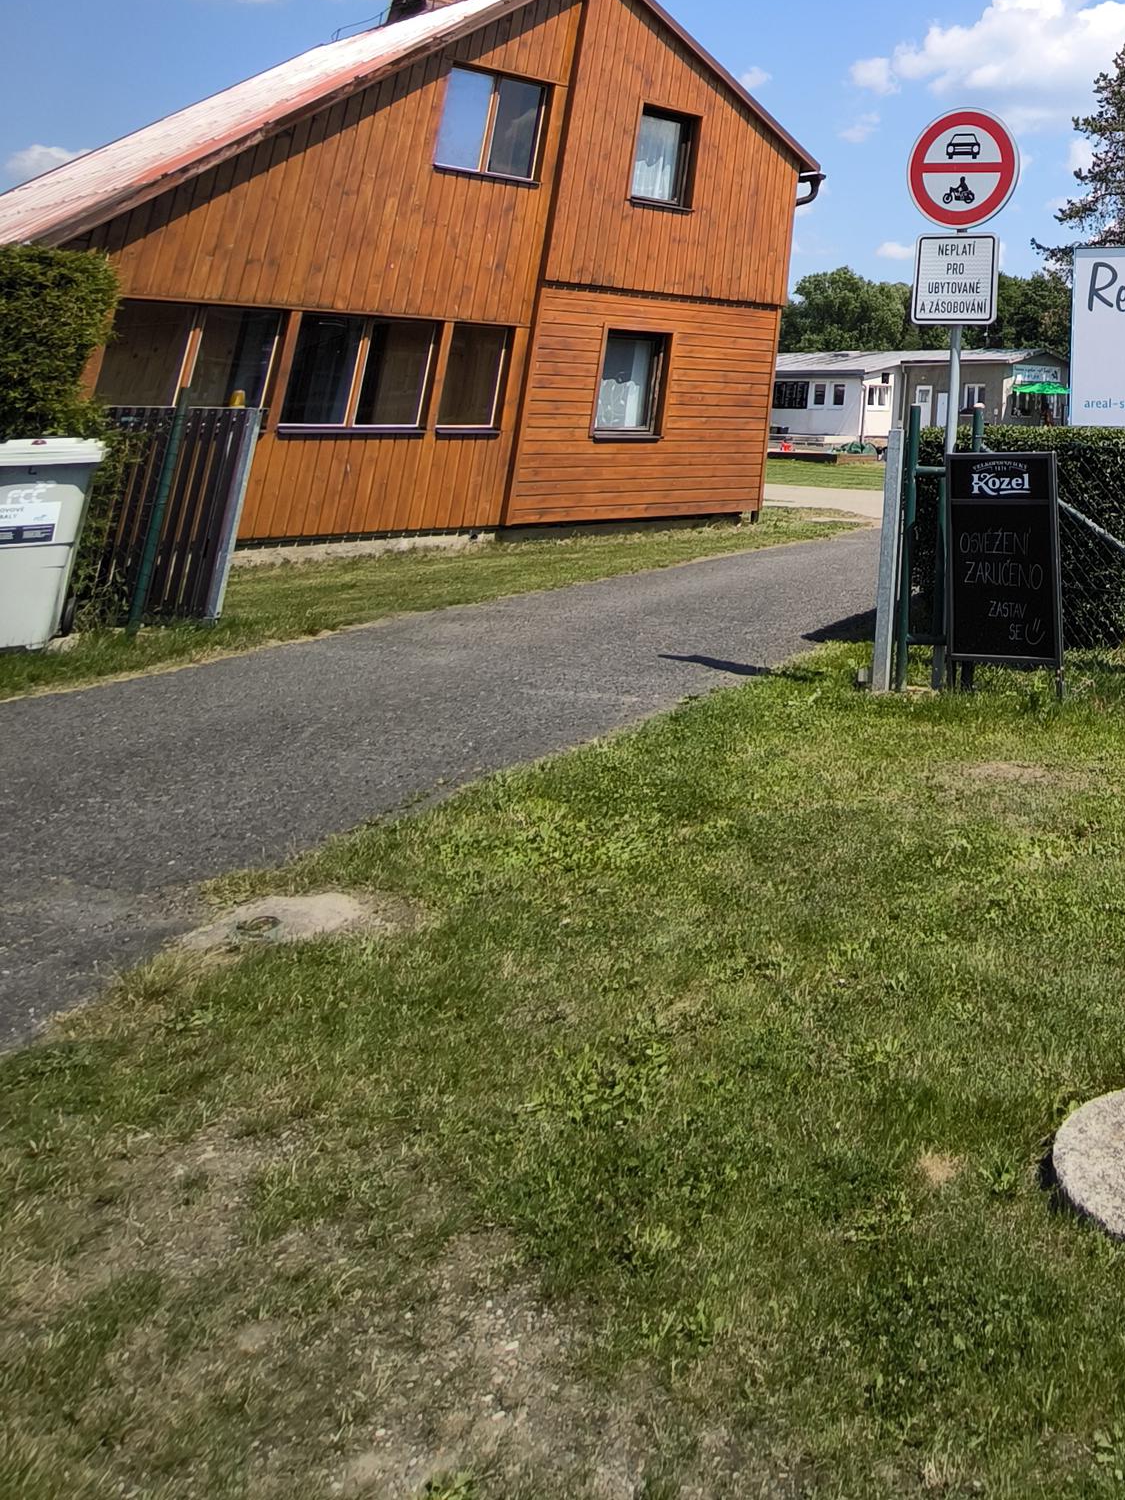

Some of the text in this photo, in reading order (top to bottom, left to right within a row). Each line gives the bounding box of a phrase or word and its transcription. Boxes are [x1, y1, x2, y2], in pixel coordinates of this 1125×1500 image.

[938, 241, 976, 256] NEPLATÍ
[946, 262, 965, 276] PRO
[928, 279, 981, 294] UBYTOVANÉ
[919, 299, 987, 314] A ZÁSOBOVÁNÍ
[971, 473, 1030, 495] Kozel
[964, 558, 1043, 590] ZARUČENO
[1008, 623, 1023, 640] SE
